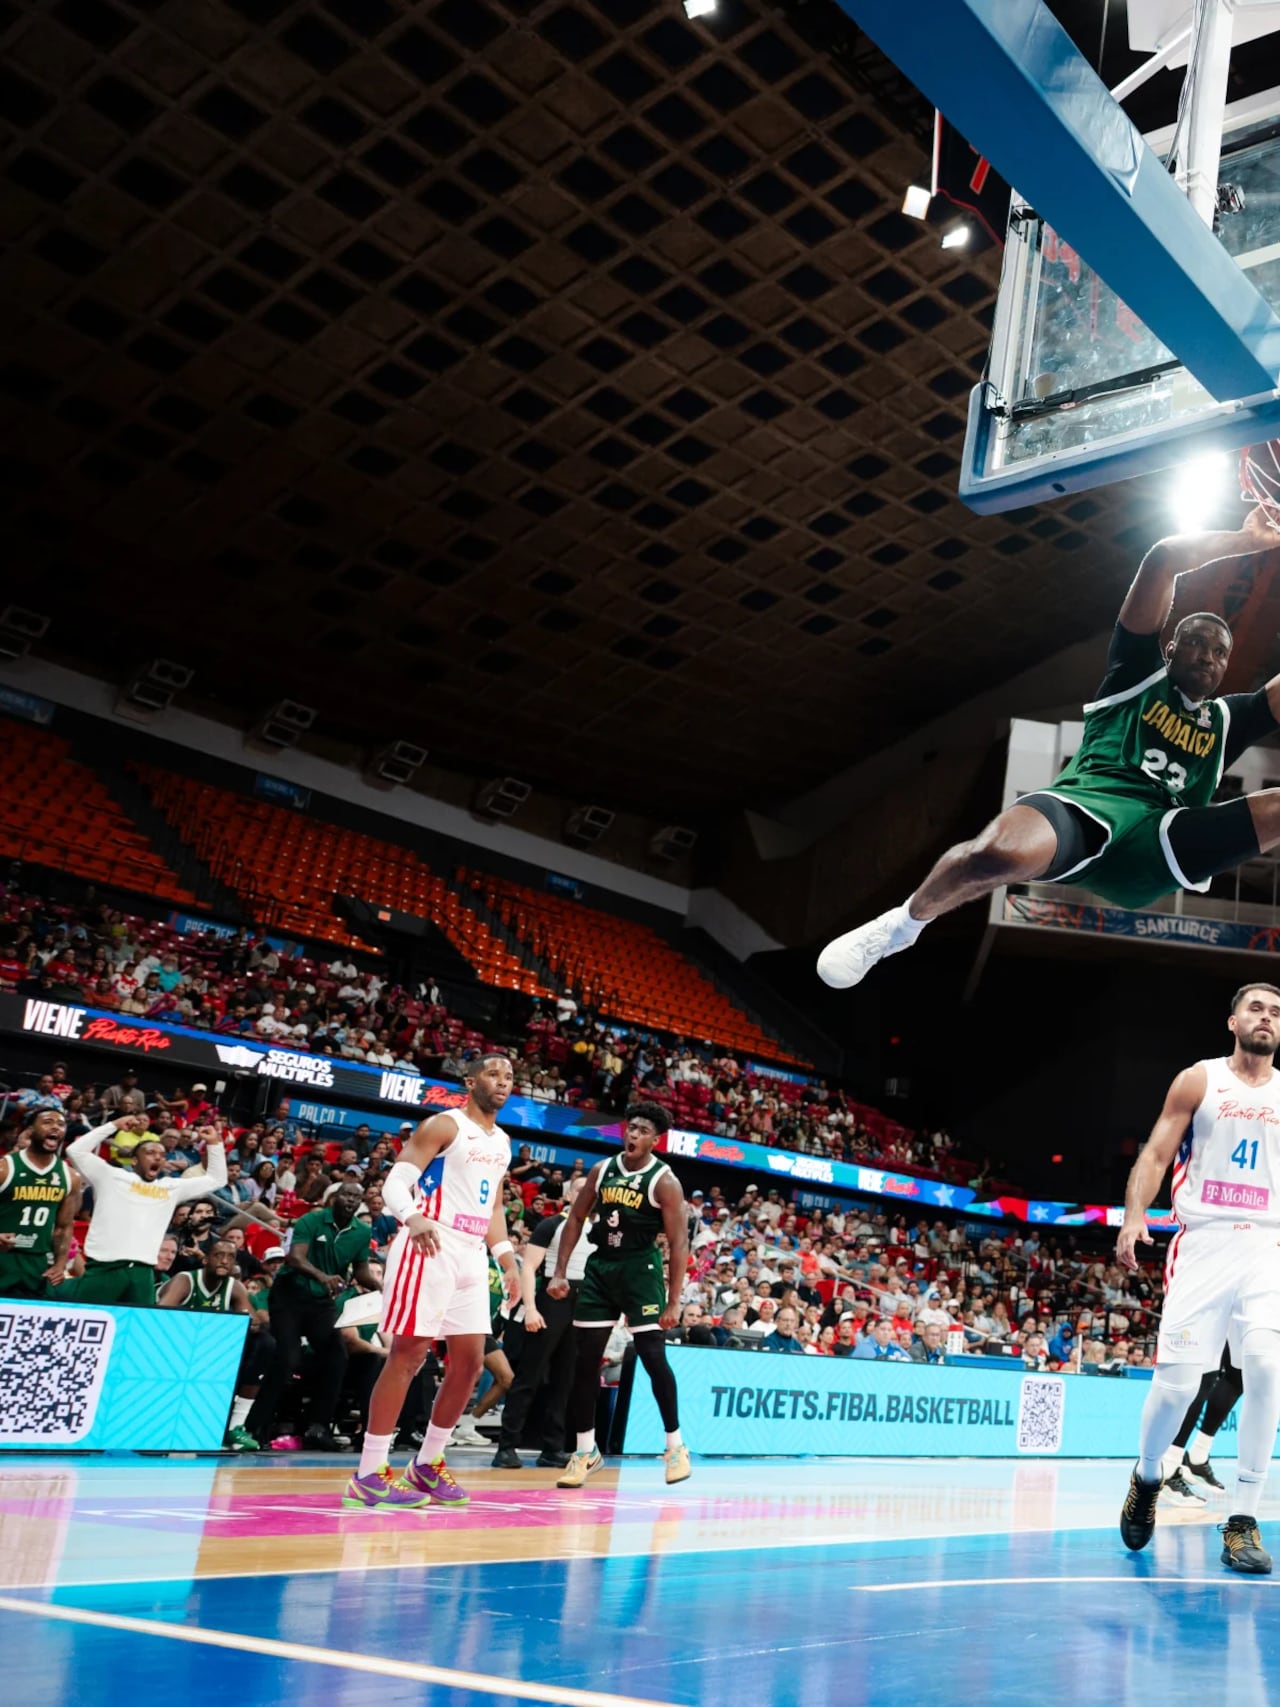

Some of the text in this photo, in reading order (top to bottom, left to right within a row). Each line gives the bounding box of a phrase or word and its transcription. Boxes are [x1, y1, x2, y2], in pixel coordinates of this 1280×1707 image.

[1140, 748, 1187, 793] 23
[1135, 918, 1220, 944] SANTURCE
[22, 999, 86, 1039] VIENE
[257, 1060, 335, 1088] MULTIPLES
[266, 1049, 333, 1075] SEGUROS
[379, 1071, 426, 1105] VIENE
[298, 1104, 347, 1126] PALCO T
[1217, 1100, 1256, 1121] Puerto
[1231, 1138, 1260, 1170] 41
[480, 1180, 489, 1204] 9
[1220, 1187, 1265, 1207] Mobile
[20, 1207, 49, 1226] 10
[711, 1386, 1015, 1426] TICKETS.FIBA.BASKETBALL
